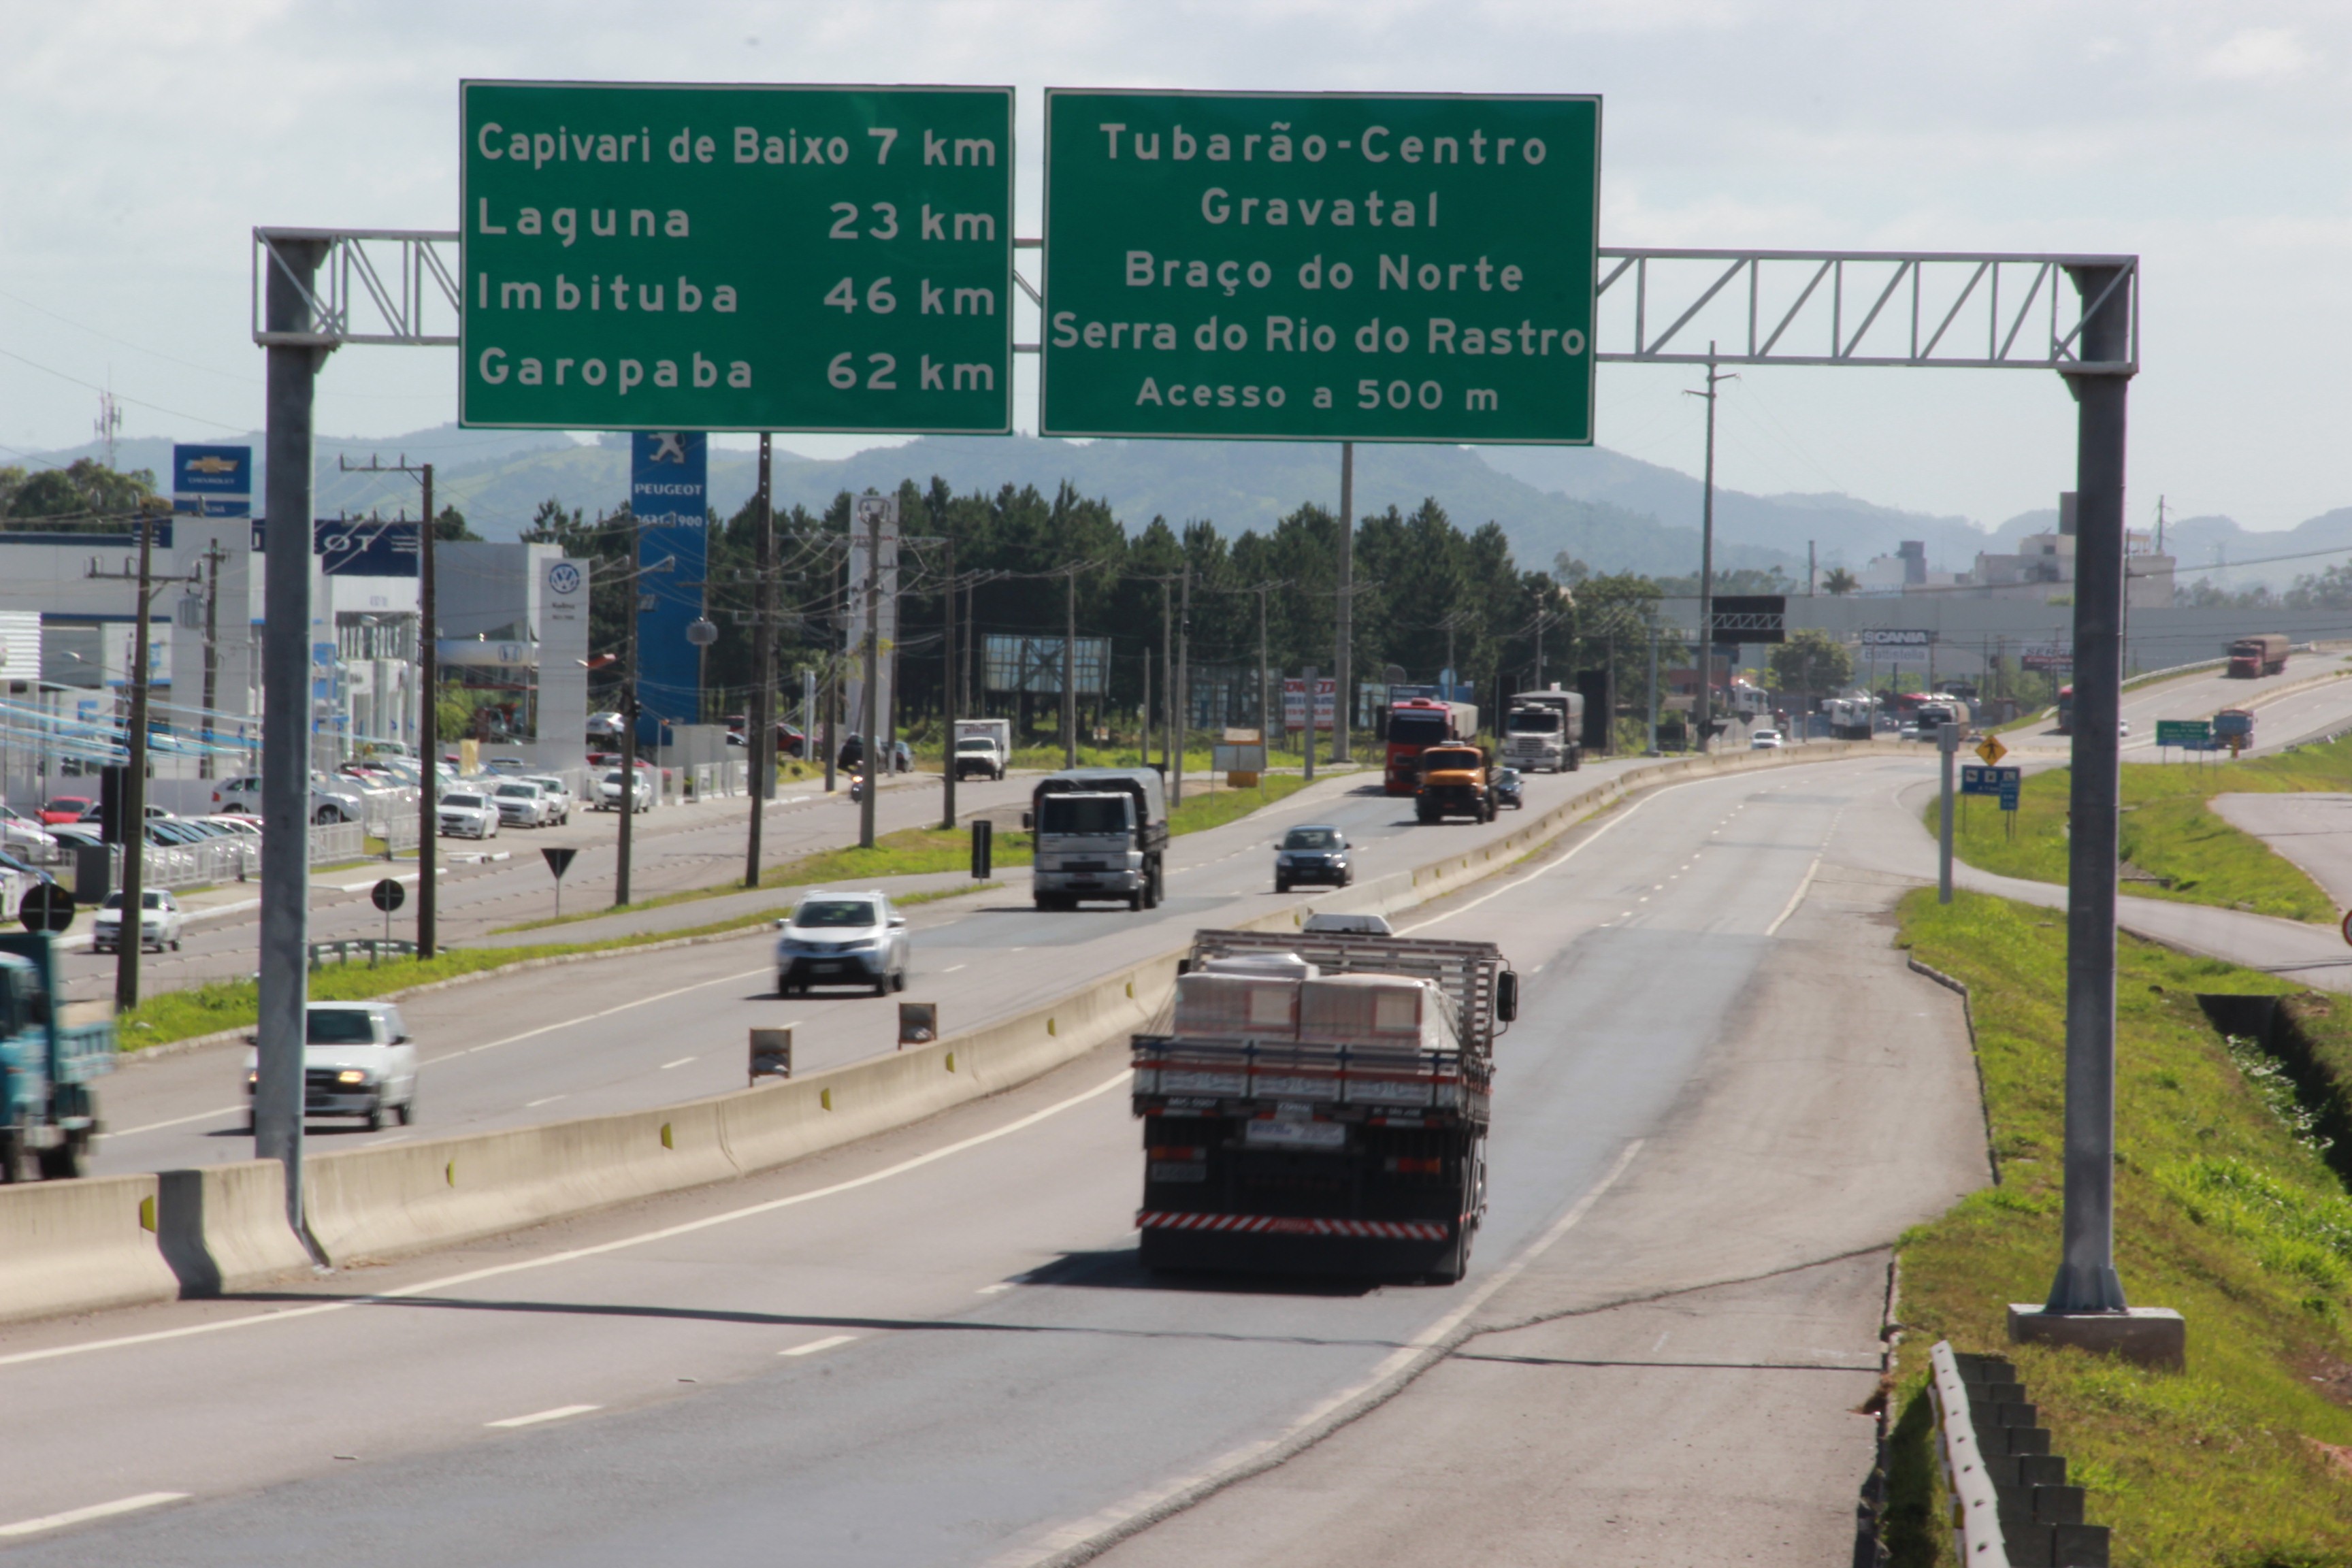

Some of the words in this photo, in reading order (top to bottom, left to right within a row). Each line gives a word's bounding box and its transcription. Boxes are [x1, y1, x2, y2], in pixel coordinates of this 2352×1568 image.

[478, 122, 650, 170] Capivari
[668, 127, 716, 163] de
[734, 127, 849, 165] Baixo
[868, 127, 898, 165] 7
[924, 129, 995, 167] km
[1099, 122, 1546, 165] Tubarão-Centro
[479, 197, 689, 247] Laguna
[829, 202, 898, 240] 23
[921, 203, 995, 241] km
[1202, 187, 1437, 227] Gravatal
[479, 272, 737, 312] Imbituba
[824, 276, 896, 314] 46
[921, 279, 994, 315] km
[1126, 250, 1271, 297] Braço
[1298, 255, 1353, 289] do
[1379, 254, 1523, 291] Norte
[1052, 311, 1176, 350] Serra
[1194, 316, 1247, 351] do
[1267, 316, 1336, 352] Rio
[1355, 318, 1409, 353] do
[1428, 318, 1585, 356] Rastro
[479, 347, 751, 395] Garopaba
[828, 352, 896, 390] 62
[921, 355, 994, 391] km
[1136, 377, 1286, 408] Acesso
[1313, 387, 1332, 408] a
[1358, 379, 1442, 410] 500
[1466, 389, 1497, 410] m
[634, 483, 702, 495] PEUGEOT
[1863, 631, 1927, 644] SCANIA
